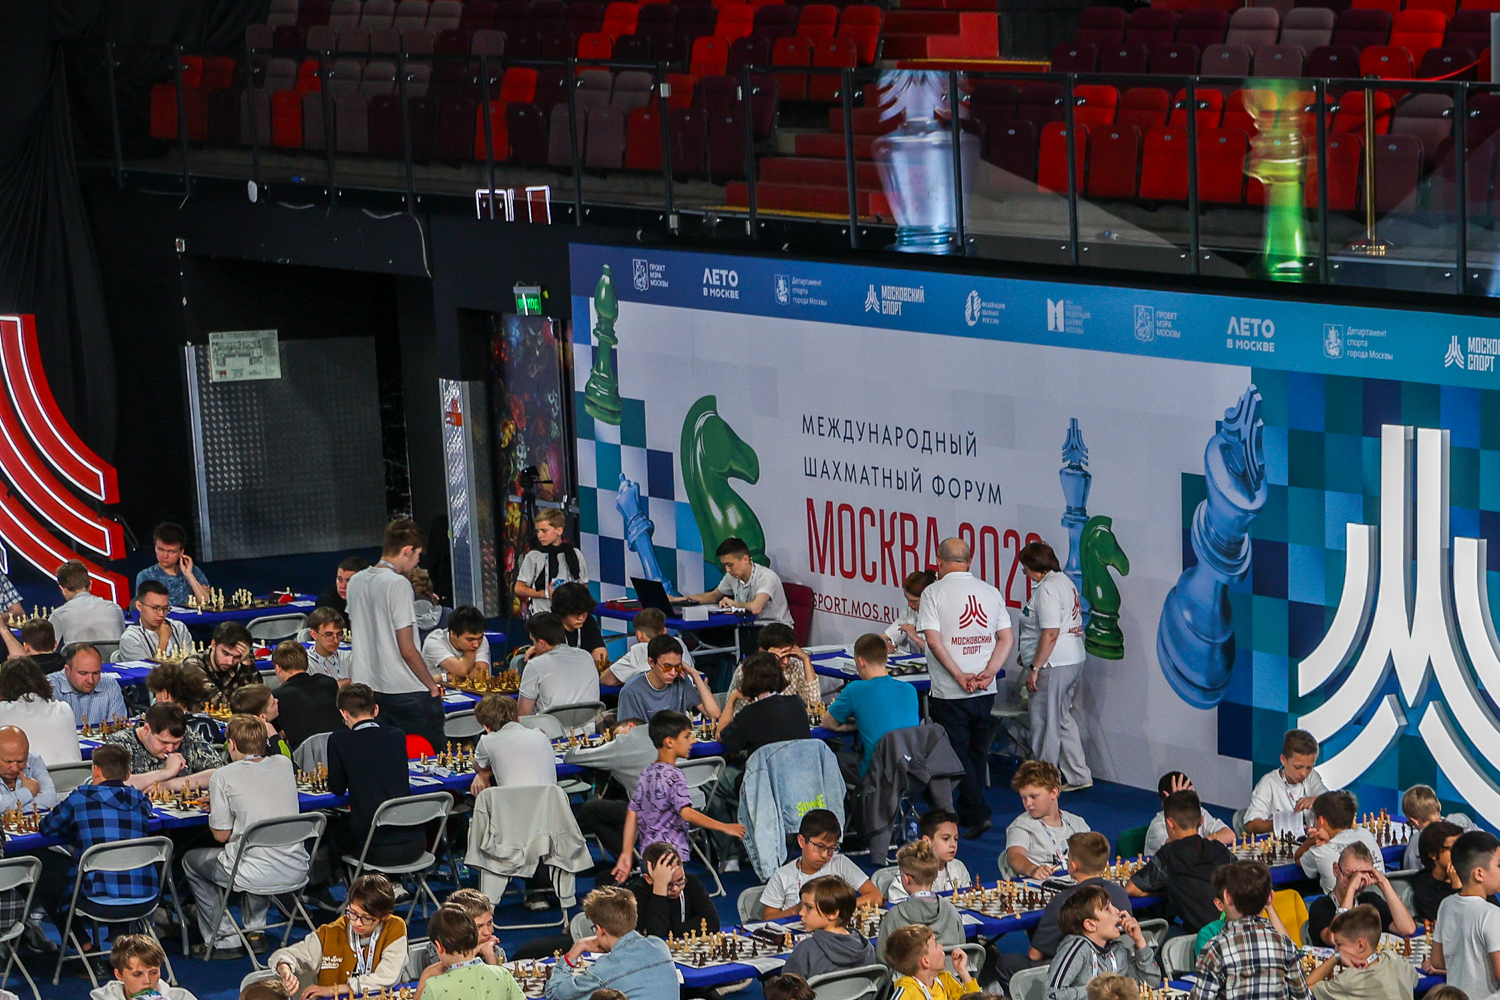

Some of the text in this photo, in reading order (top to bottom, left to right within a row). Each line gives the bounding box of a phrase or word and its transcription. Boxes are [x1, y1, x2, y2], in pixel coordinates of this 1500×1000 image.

[703, 268, 739, 287] ЛЕТО
[703, 288, 740, 299] В МОСКВЕ
[881, 284, 925, 303] МОСКОВСКИЙ
[881, 301, 902, 316] СПОРТ
[1156, 311, 1178, 320] ПРОЕКТ
[1156, 320, 1172, 329] МЭРА
[1227, 316, 1275, 338] ЛЕТО
[1156, 328, 1181, 338] МОСКВЫ
[1347, 326, 1387, 338] Департамент
[1227, 339, 1275, 353] В МОСКВЕ
[1347, 338, 1368, 348] спорта
[1347, 350, 1394, 361] города Москвы
[1467, 355, 1495, 372] СПОРТ
[802, 414, 977, 457] МЕЖДУНАРОДНЫЙ
[804, 456, 1002, 505] ШАХМАТНЫЙ ФОРУМ
[951, 634, 992, 645] МОСКОВСКИЙ
[963, 645, 982, 655] СПОРТ
